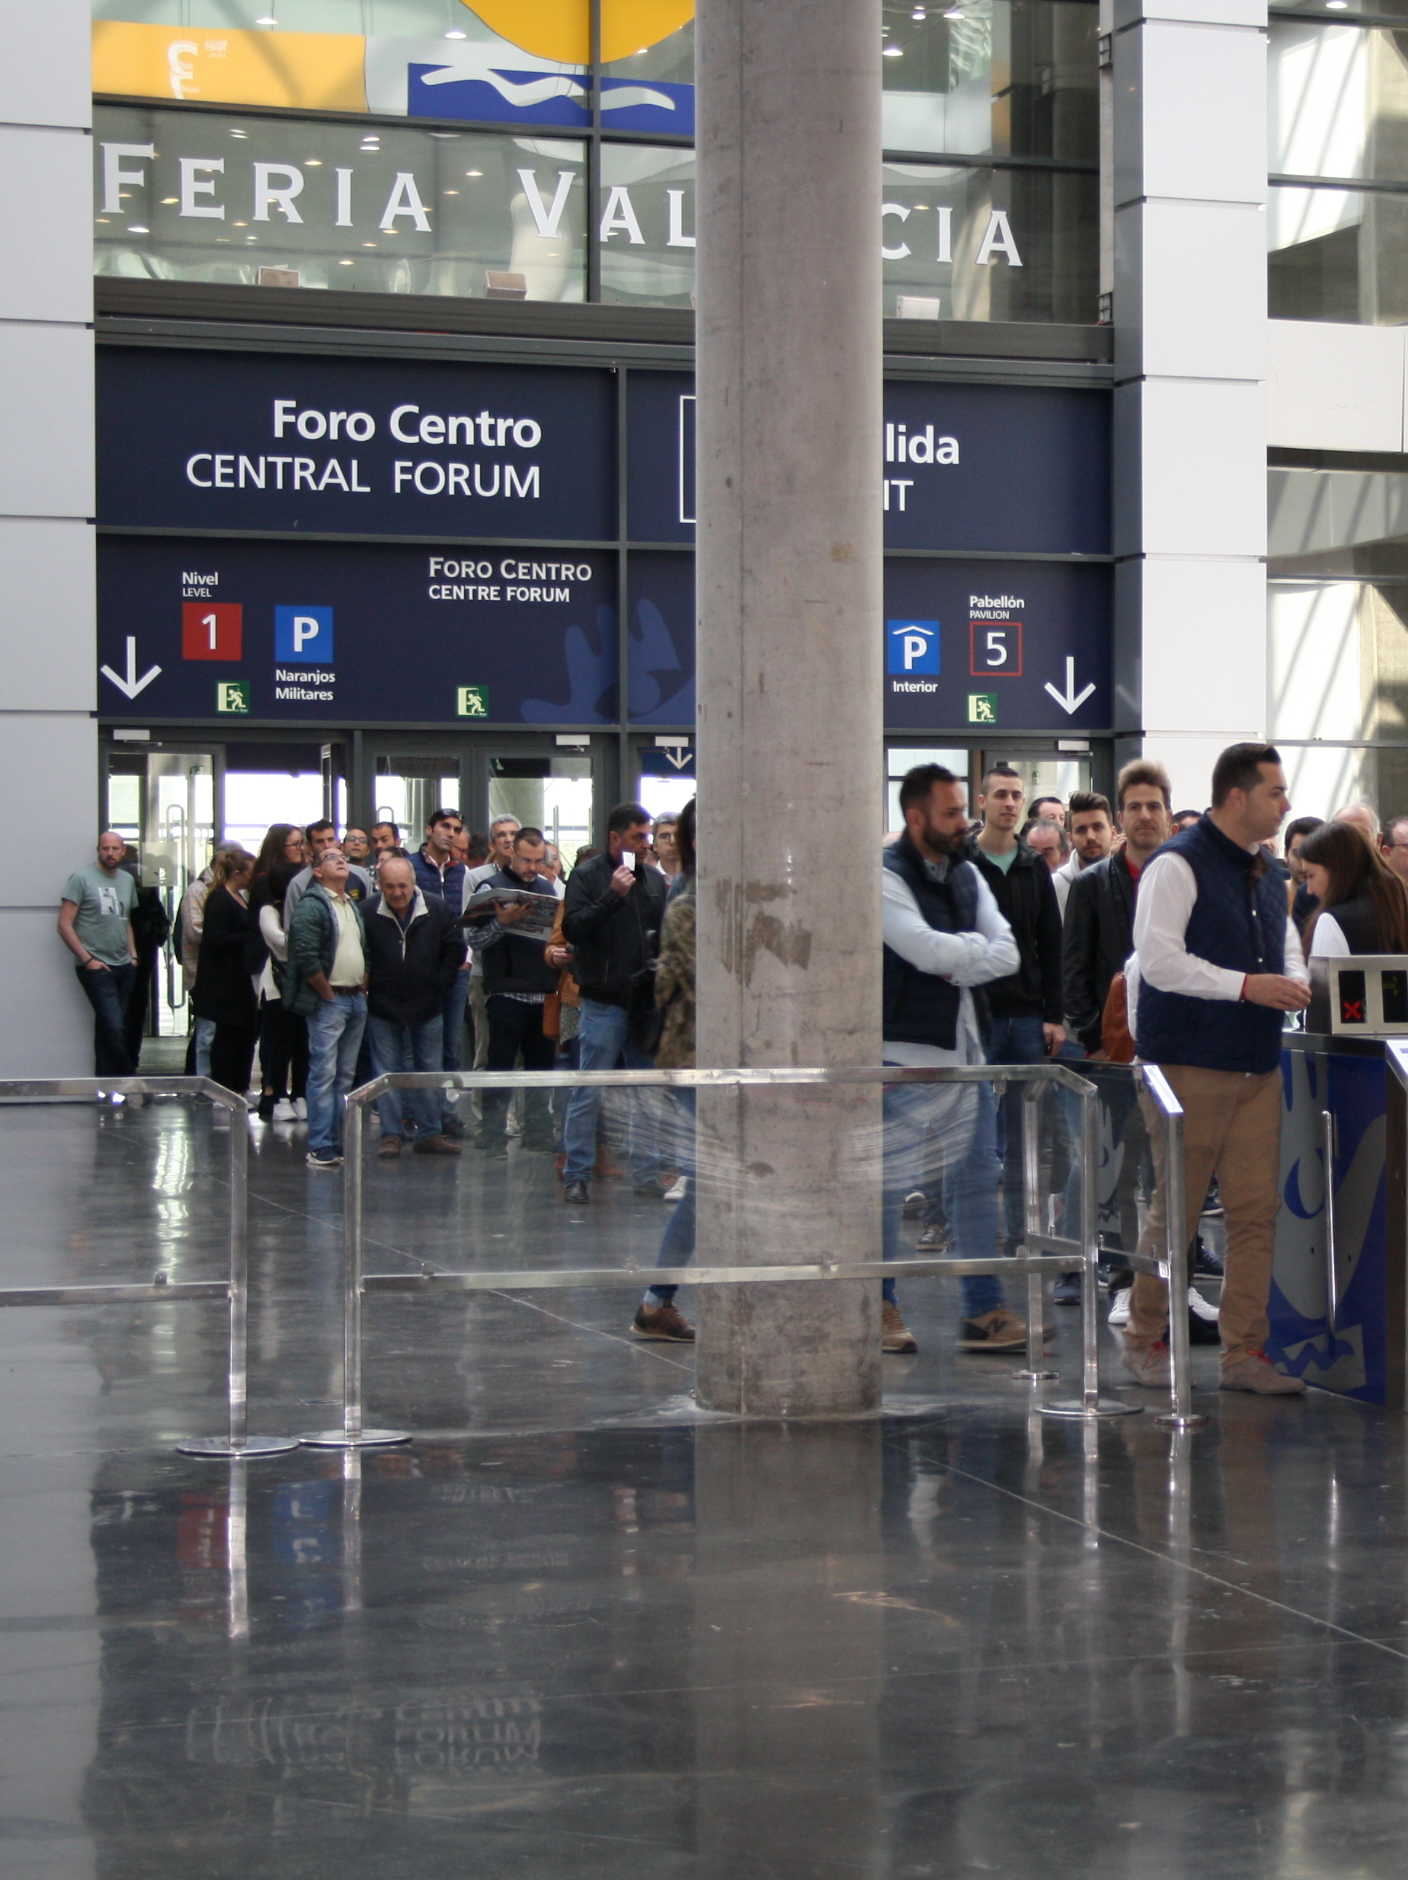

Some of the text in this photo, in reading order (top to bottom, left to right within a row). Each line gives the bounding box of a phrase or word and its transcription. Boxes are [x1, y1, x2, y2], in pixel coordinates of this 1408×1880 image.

[99, 142, 1023, 267] FERIA VALCIA
[275, 400, 541, 448] Foro Centro
[887, 424, 960, 465] lida
[186, 453, 541, 498] CENTRAL FORUM
[182, 571, 218, 586] Nivel
[429, 556, 591, 582] FORO CENTRO
[182, 588, 211, 597] LEVEL
[428, 585, 570, 603] CENTRE FORUM
[969, 595, 1025, 610] Pabellón
[969, 610, 1010, 619] PAVILION
[201, 614, 217, 650] 1
[294, 616, 319, 652] P
[904, 636, 928, 669] P
[986, 632, 1008, 666] 5
[275, 669, 336, 686] Naranjos
[893, 680, 939, 693] Interior
[275, 687, 334, 702] Militares
